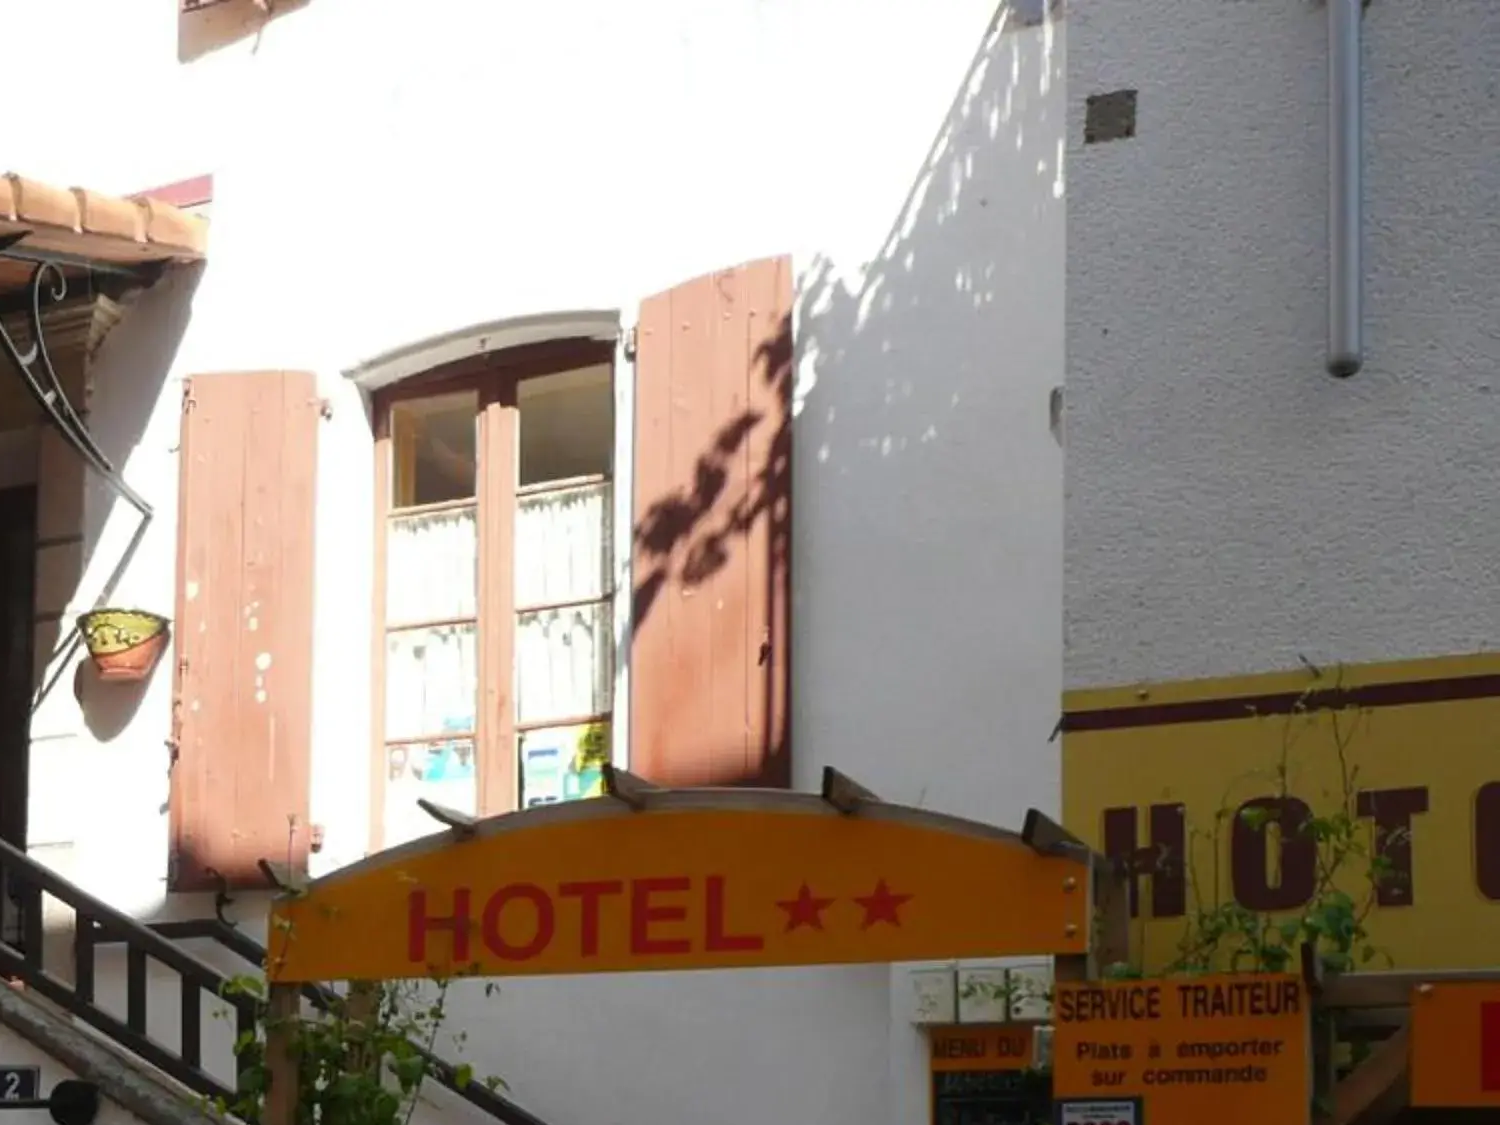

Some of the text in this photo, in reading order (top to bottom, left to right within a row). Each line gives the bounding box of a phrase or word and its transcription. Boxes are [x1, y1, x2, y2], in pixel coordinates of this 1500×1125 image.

[406, 874, 764, 963] HOTEL
[1059, 982, 1300, 1023] SERVICE TRAITEUR
[933, 1036, 1026, 1059] MENU DU
[1077, 1041, 1132, 1060] Plats
[1177, 1039, 1283, 1060] emporter
[4, 1071, 20, 1101] 2
[1091, 1064, 1268, 1086] sur commande
